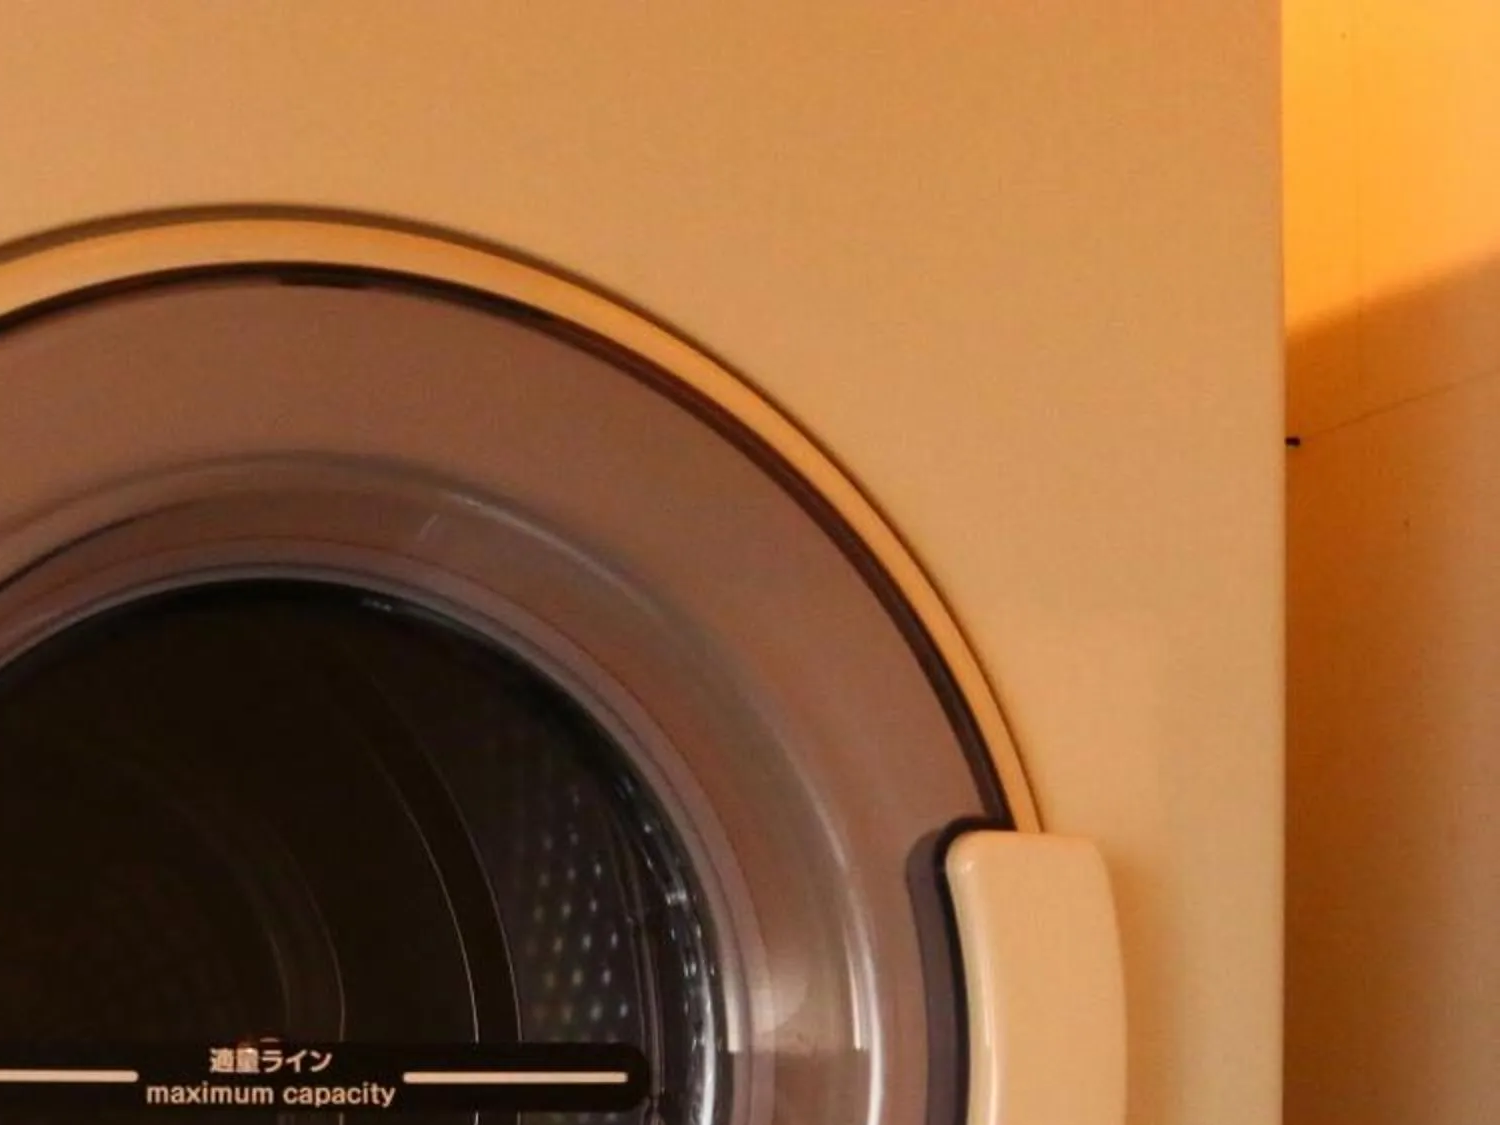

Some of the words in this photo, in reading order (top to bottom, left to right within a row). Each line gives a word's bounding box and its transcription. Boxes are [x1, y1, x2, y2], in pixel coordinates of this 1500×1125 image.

[209, 1047, 333, 1074] 適量ライン
[146, 1081, 274, 1104] maximum
[282, 1081, 396, 1108] capacity
